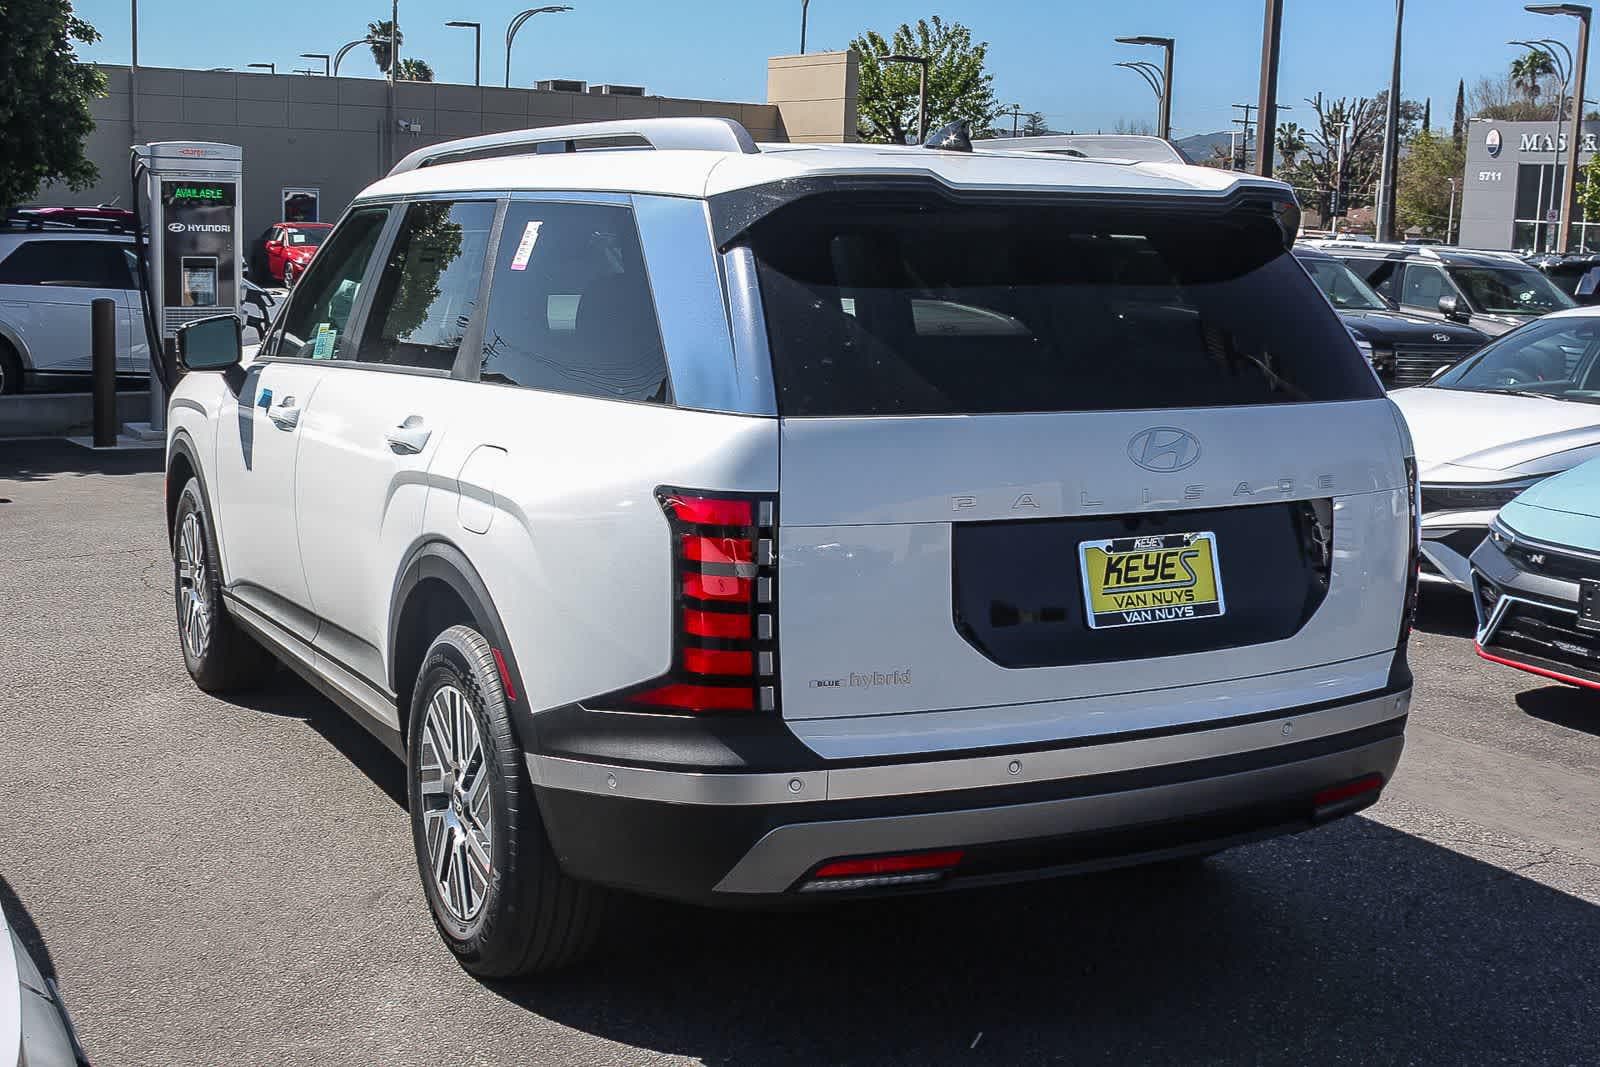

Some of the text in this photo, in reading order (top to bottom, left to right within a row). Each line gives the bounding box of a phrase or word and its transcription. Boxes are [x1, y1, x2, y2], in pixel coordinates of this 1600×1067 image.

[1519, 133, 1598, 151] MASR
[1479, 171, 1502, 181] 5711
[175, 187, 223, 199] AVAILABLE
[187, 223, 231, 233] HYUNDAI
[951, 473, 1337, 512] PALISADE
[1134, 536, 1164, 549] KEYES
[1103, 550, 1200, 588] KEYES
[1113, 589, 1195, 608] VAN NUYS
[1122, 605, 1195, 623] VAN NUYS
[848, 669, 912, 690] hybrid
